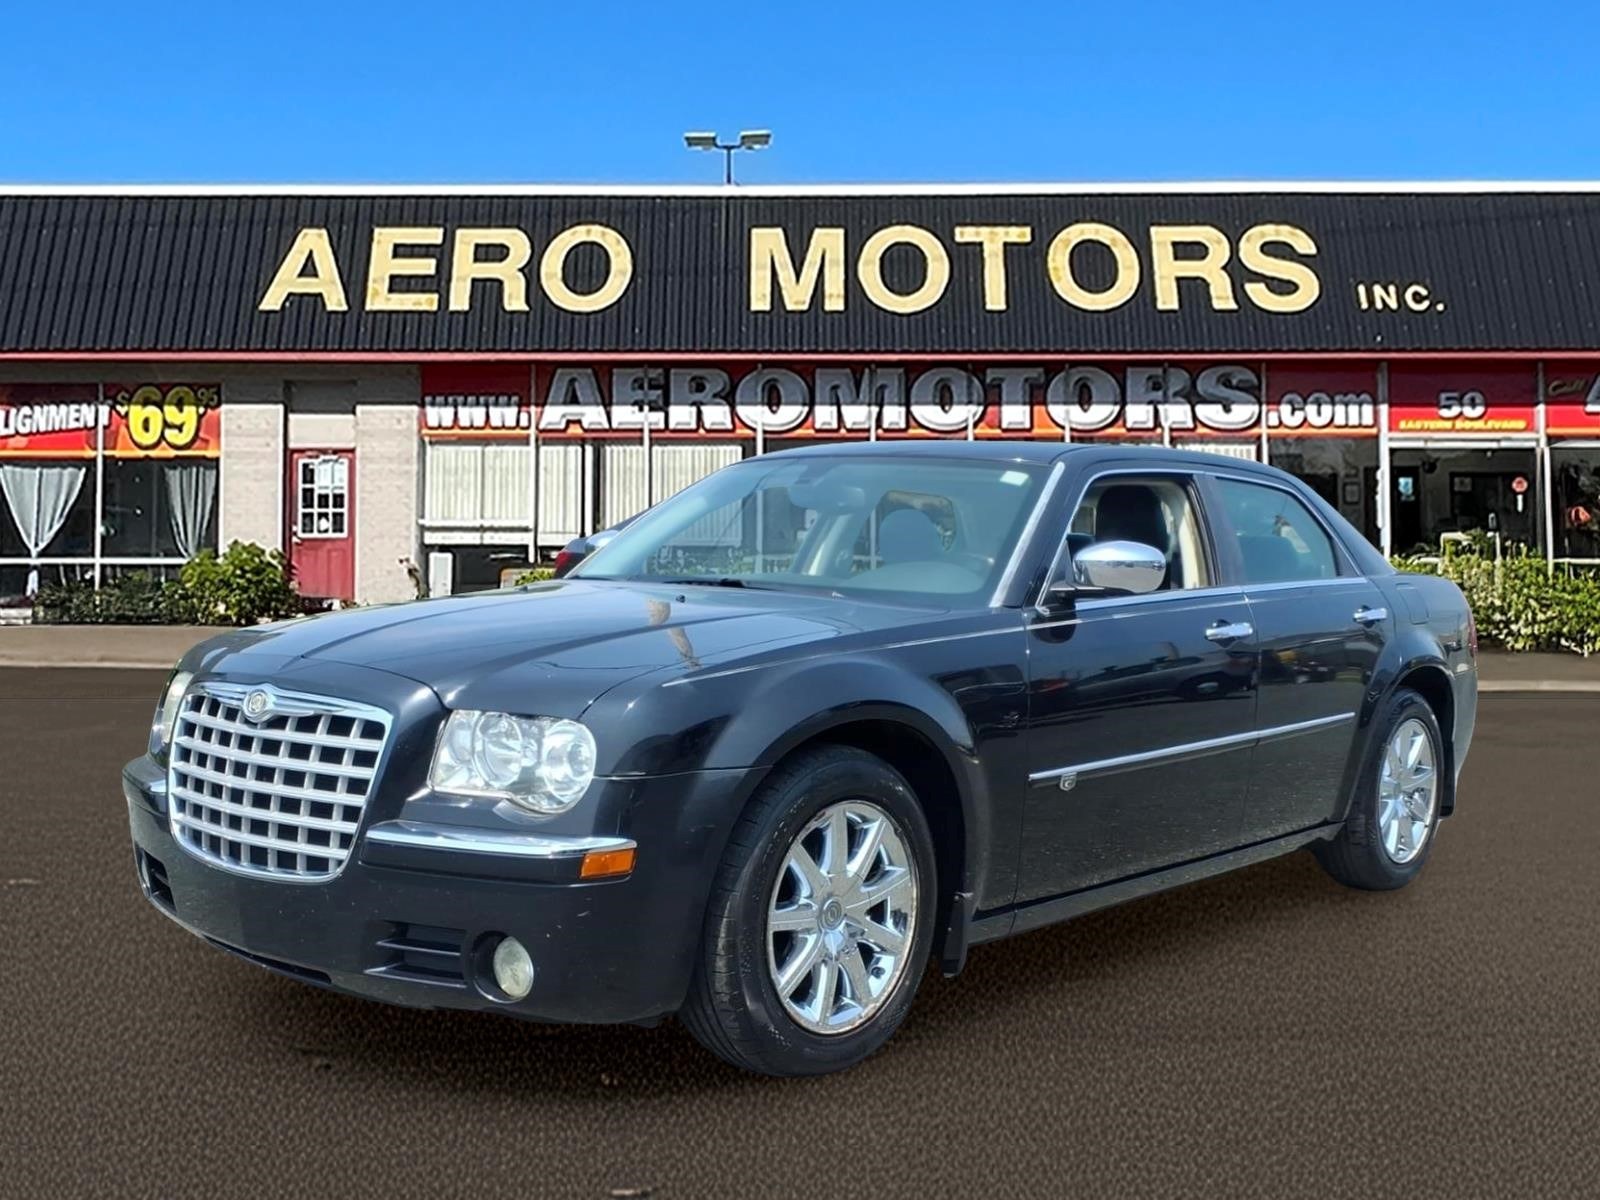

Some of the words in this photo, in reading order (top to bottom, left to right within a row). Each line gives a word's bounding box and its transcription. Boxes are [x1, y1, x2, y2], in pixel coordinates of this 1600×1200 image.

[258, 223, 634, 314] AERO
[749, 222, 1321, 314] MOTORS
[1356, 282, 1447, 313] INC.
[1438, 391, 1486, 419] 50
